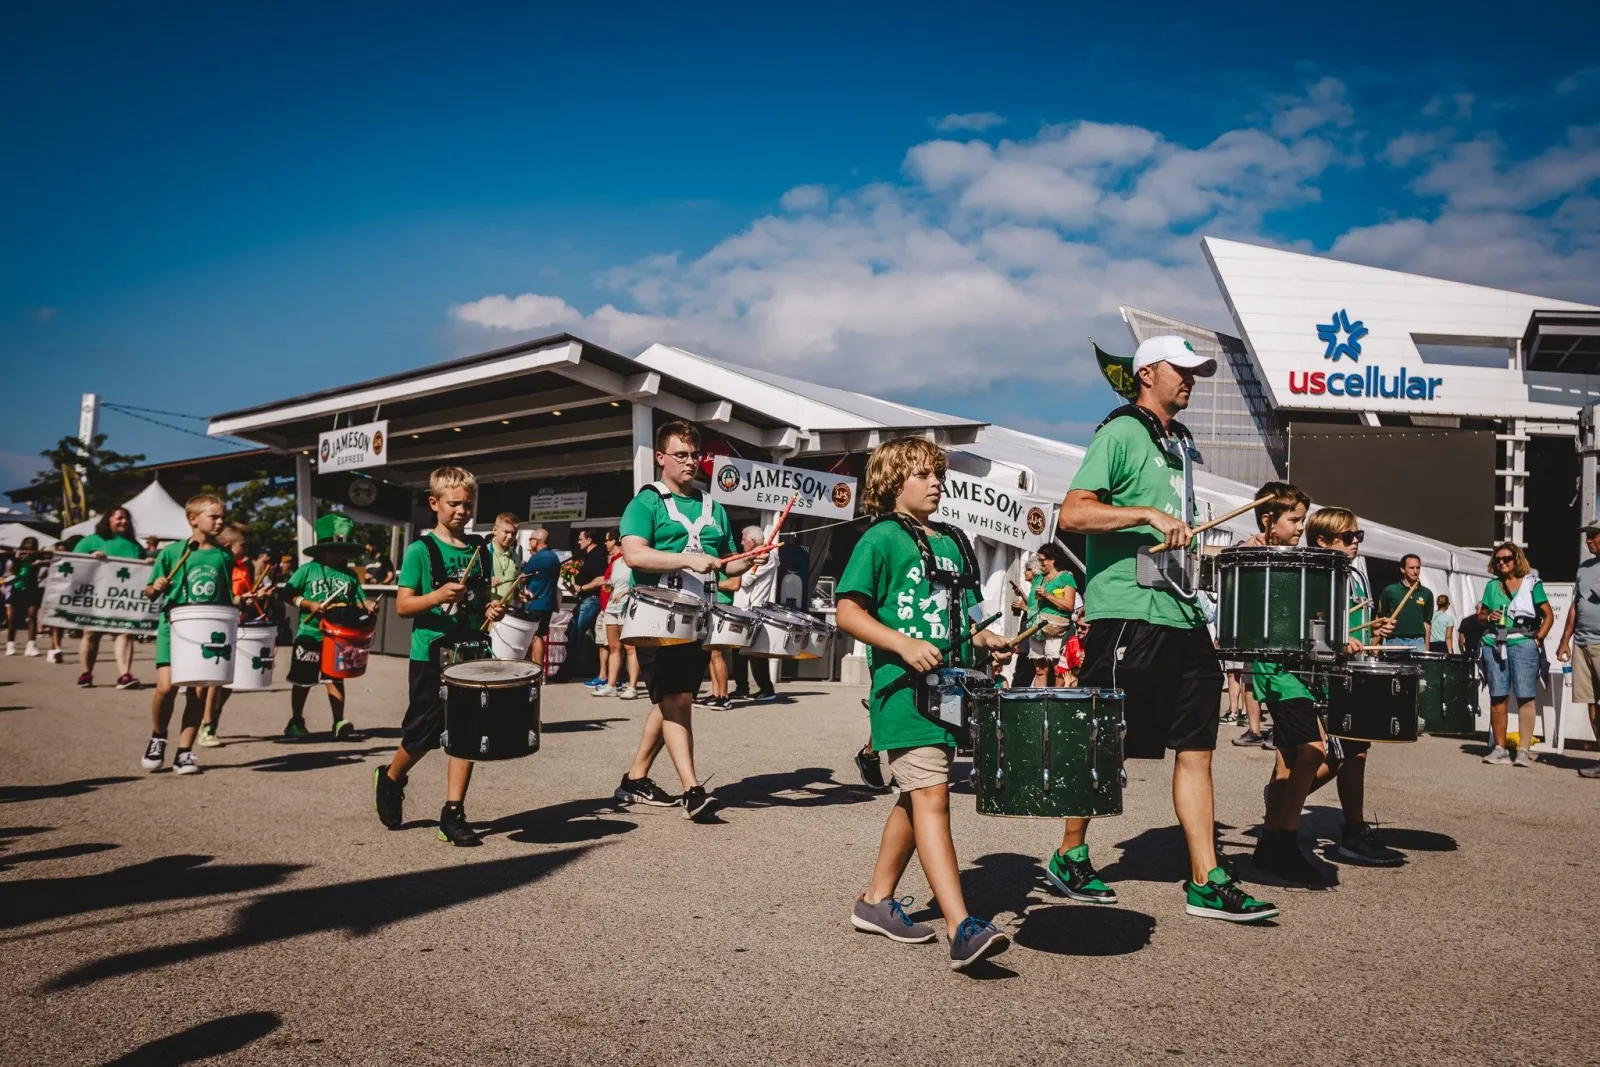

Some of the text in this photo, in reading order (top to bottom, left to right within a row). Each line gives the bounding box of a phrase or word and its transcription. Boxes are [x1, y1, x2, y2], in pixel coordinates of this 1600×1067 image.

[331, 431, 370, 459] JAMESON
[337, 453, 364, 466] EXPRESS
[742, 469, 827, 501] JAMESON
[940, 480, 1023, 522] AMESON
[936, 505, 1027, 540] ISH WHISKEY
[74, 583, 98, 596] JR.
